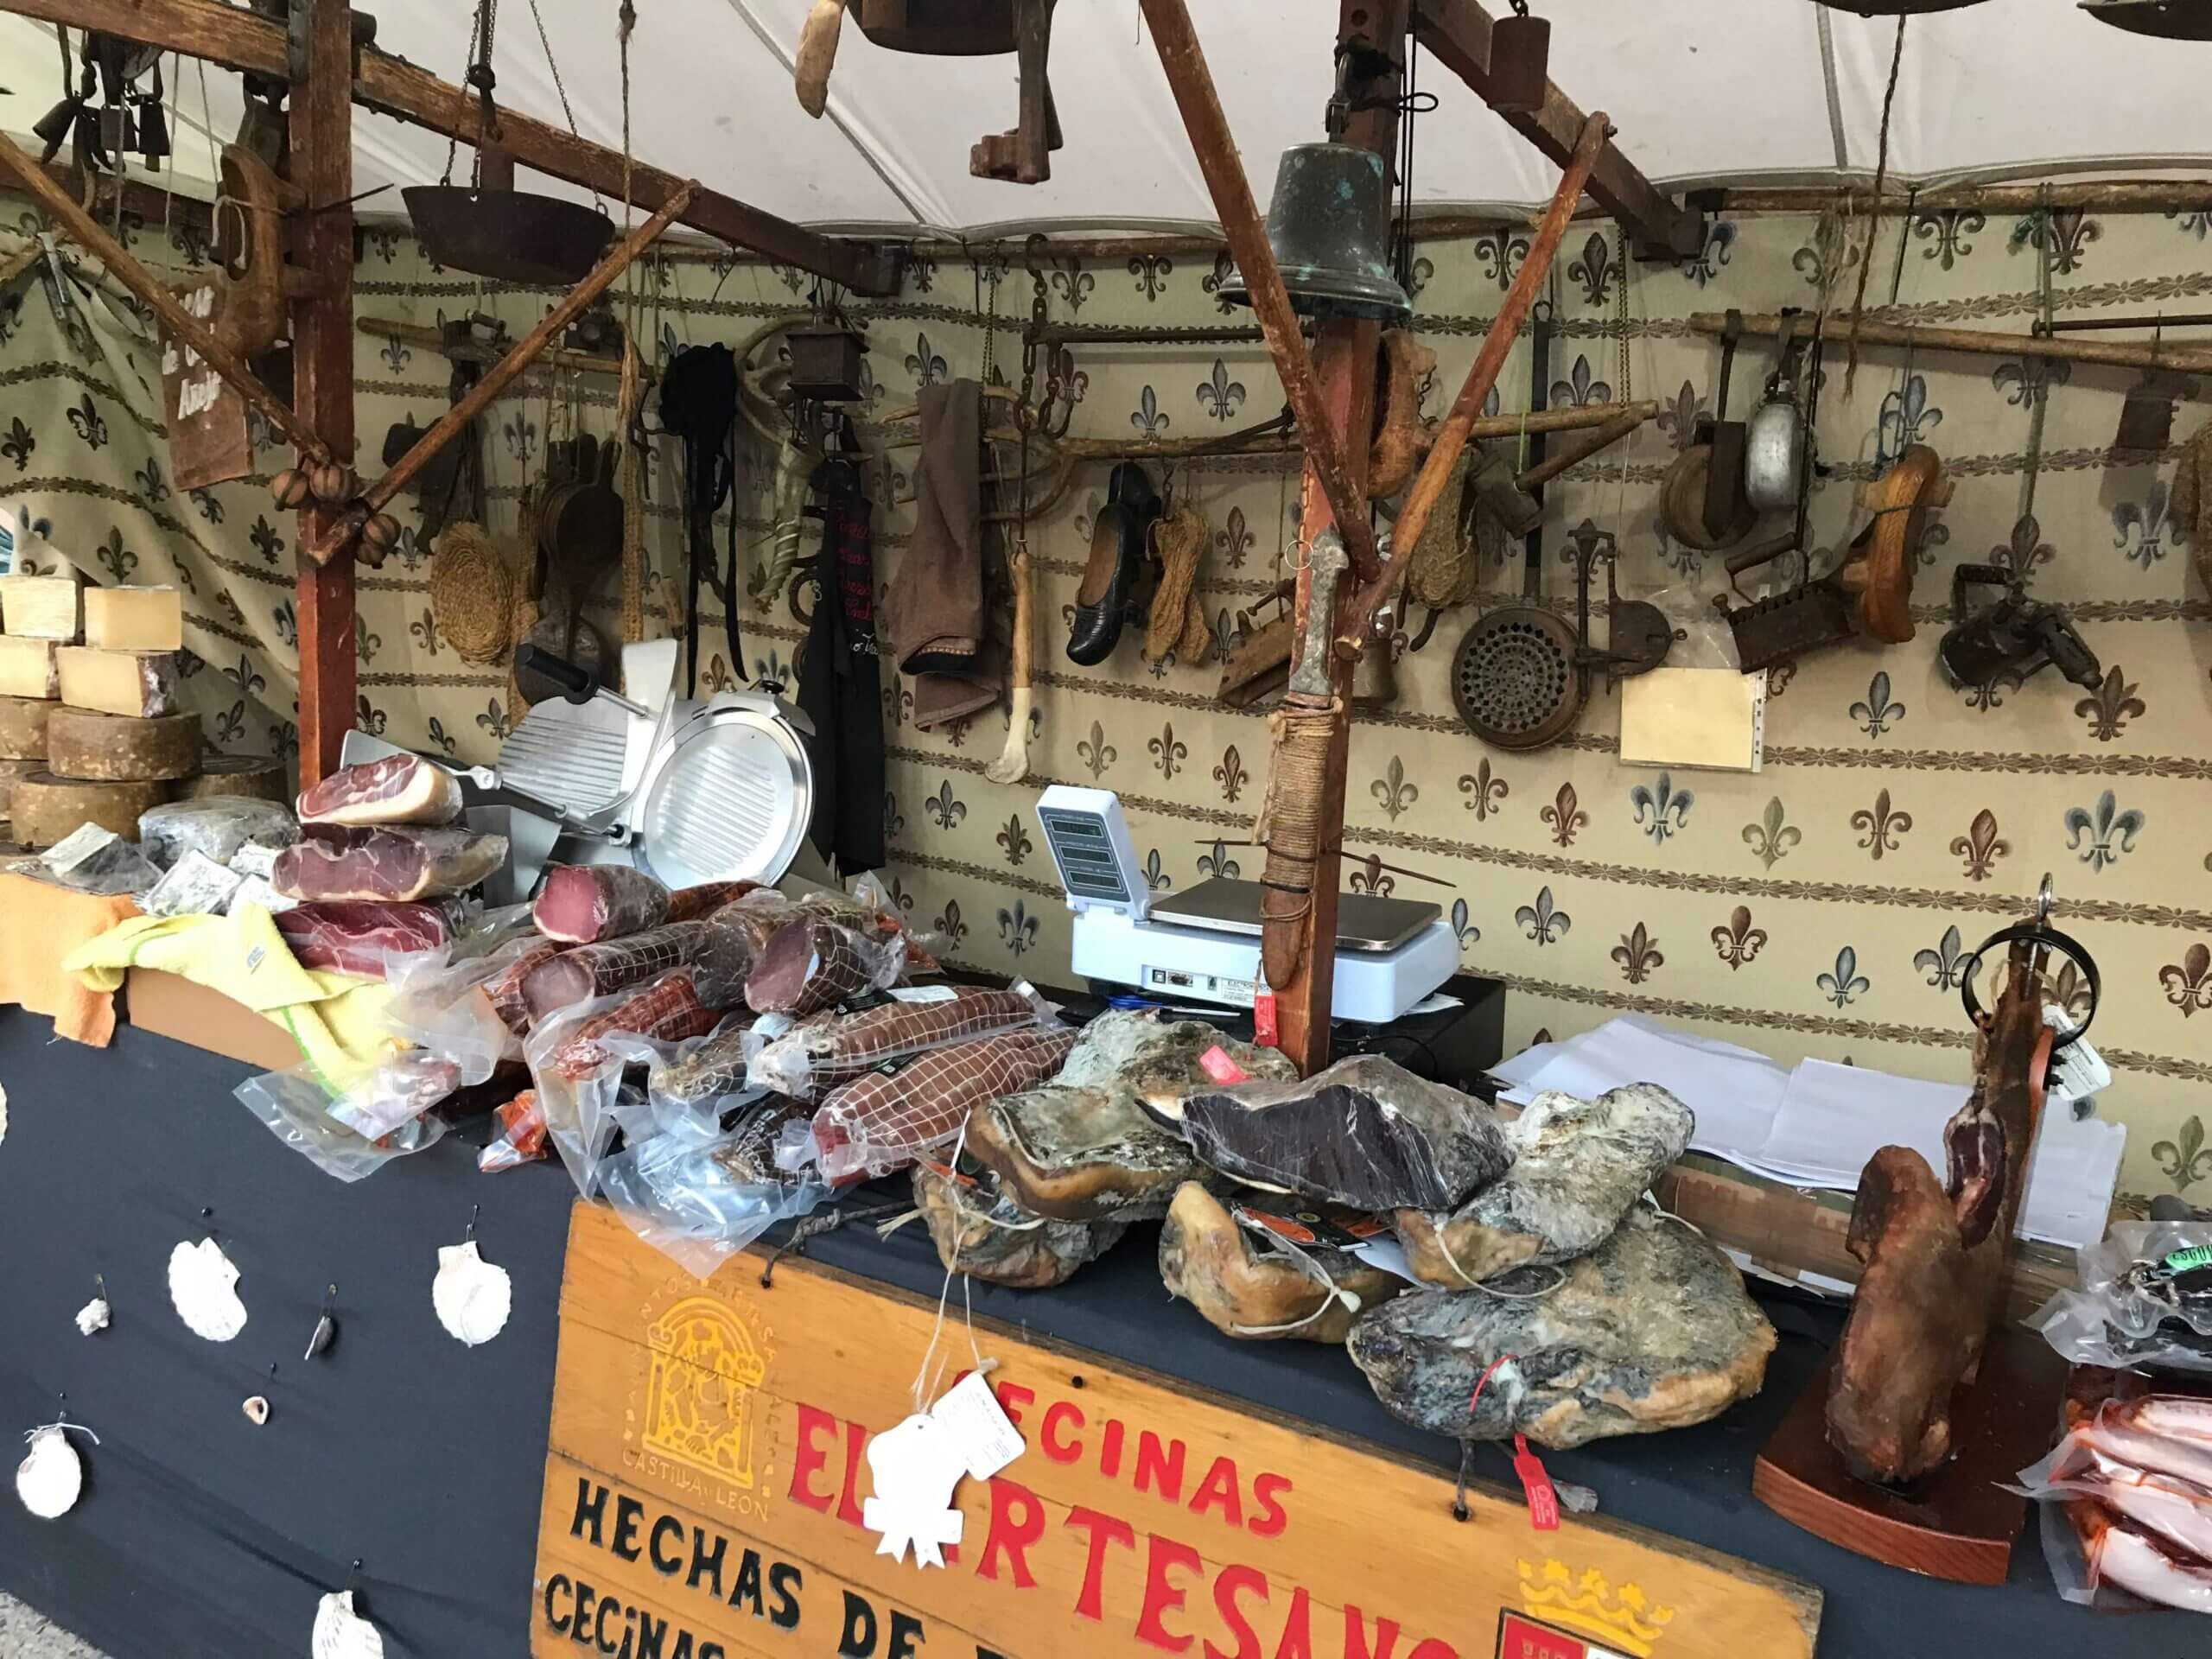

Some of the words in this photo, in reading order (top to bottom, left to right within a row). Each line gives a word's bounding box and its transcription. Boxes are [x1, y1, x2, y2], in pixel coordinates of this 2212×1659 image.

[715, 1485, 769, 1522] LEON
[952, 1370, 1294, 1538] ECINAS
[570, 1477, 803, 1631] HECHAS
[837, 1589, 926, 1659] DE
[942, 1474, 1460, 1659] RTESAN
